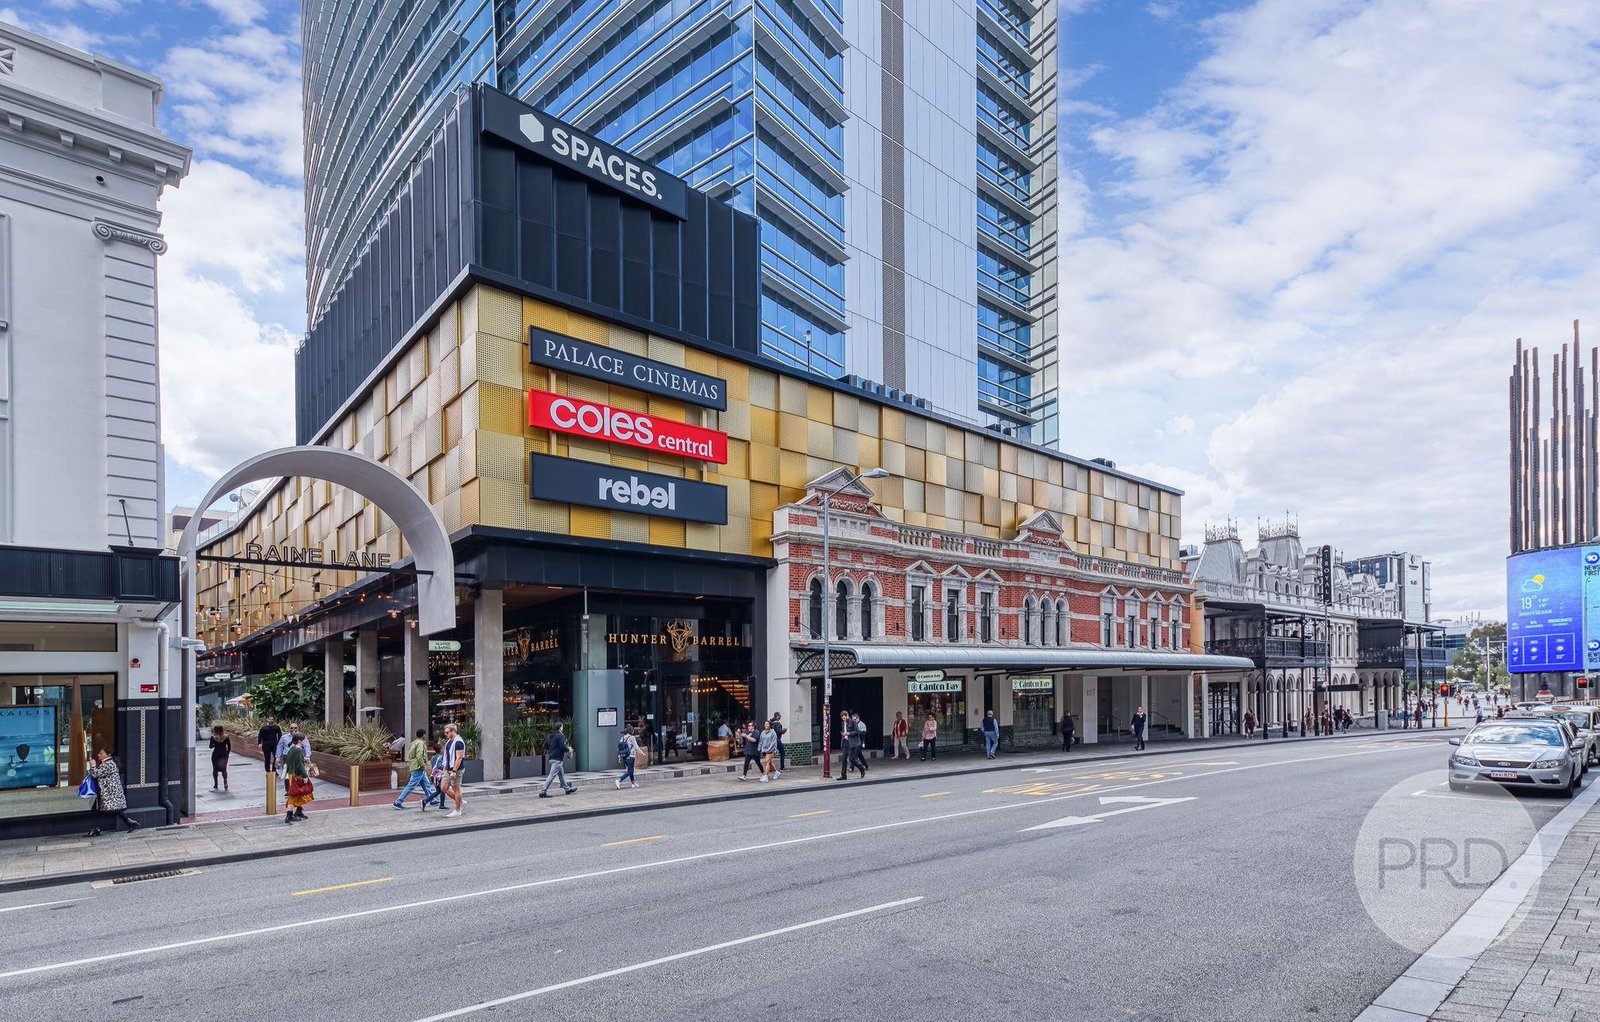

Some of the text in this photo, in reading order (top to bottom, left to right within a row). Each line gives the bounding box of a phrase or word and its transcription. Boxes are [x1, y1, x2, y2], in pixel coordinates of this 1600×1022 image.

[550, 127, 663, 200] SPACES.
[543, 339, 719, 400] PALACE CINEMAS
[549, 398, 714, 458] coles central
[598, 476, 676, 511] rebel
[246, 542, 391, 569] RAINE LANE
[530, 638, 559, 652] BARREL
[608, 633, 740, 647] HUNTER BARREL
[919, 682, 959, 691] Canton Bay
[1019, 680, 1039, 688] Canton
